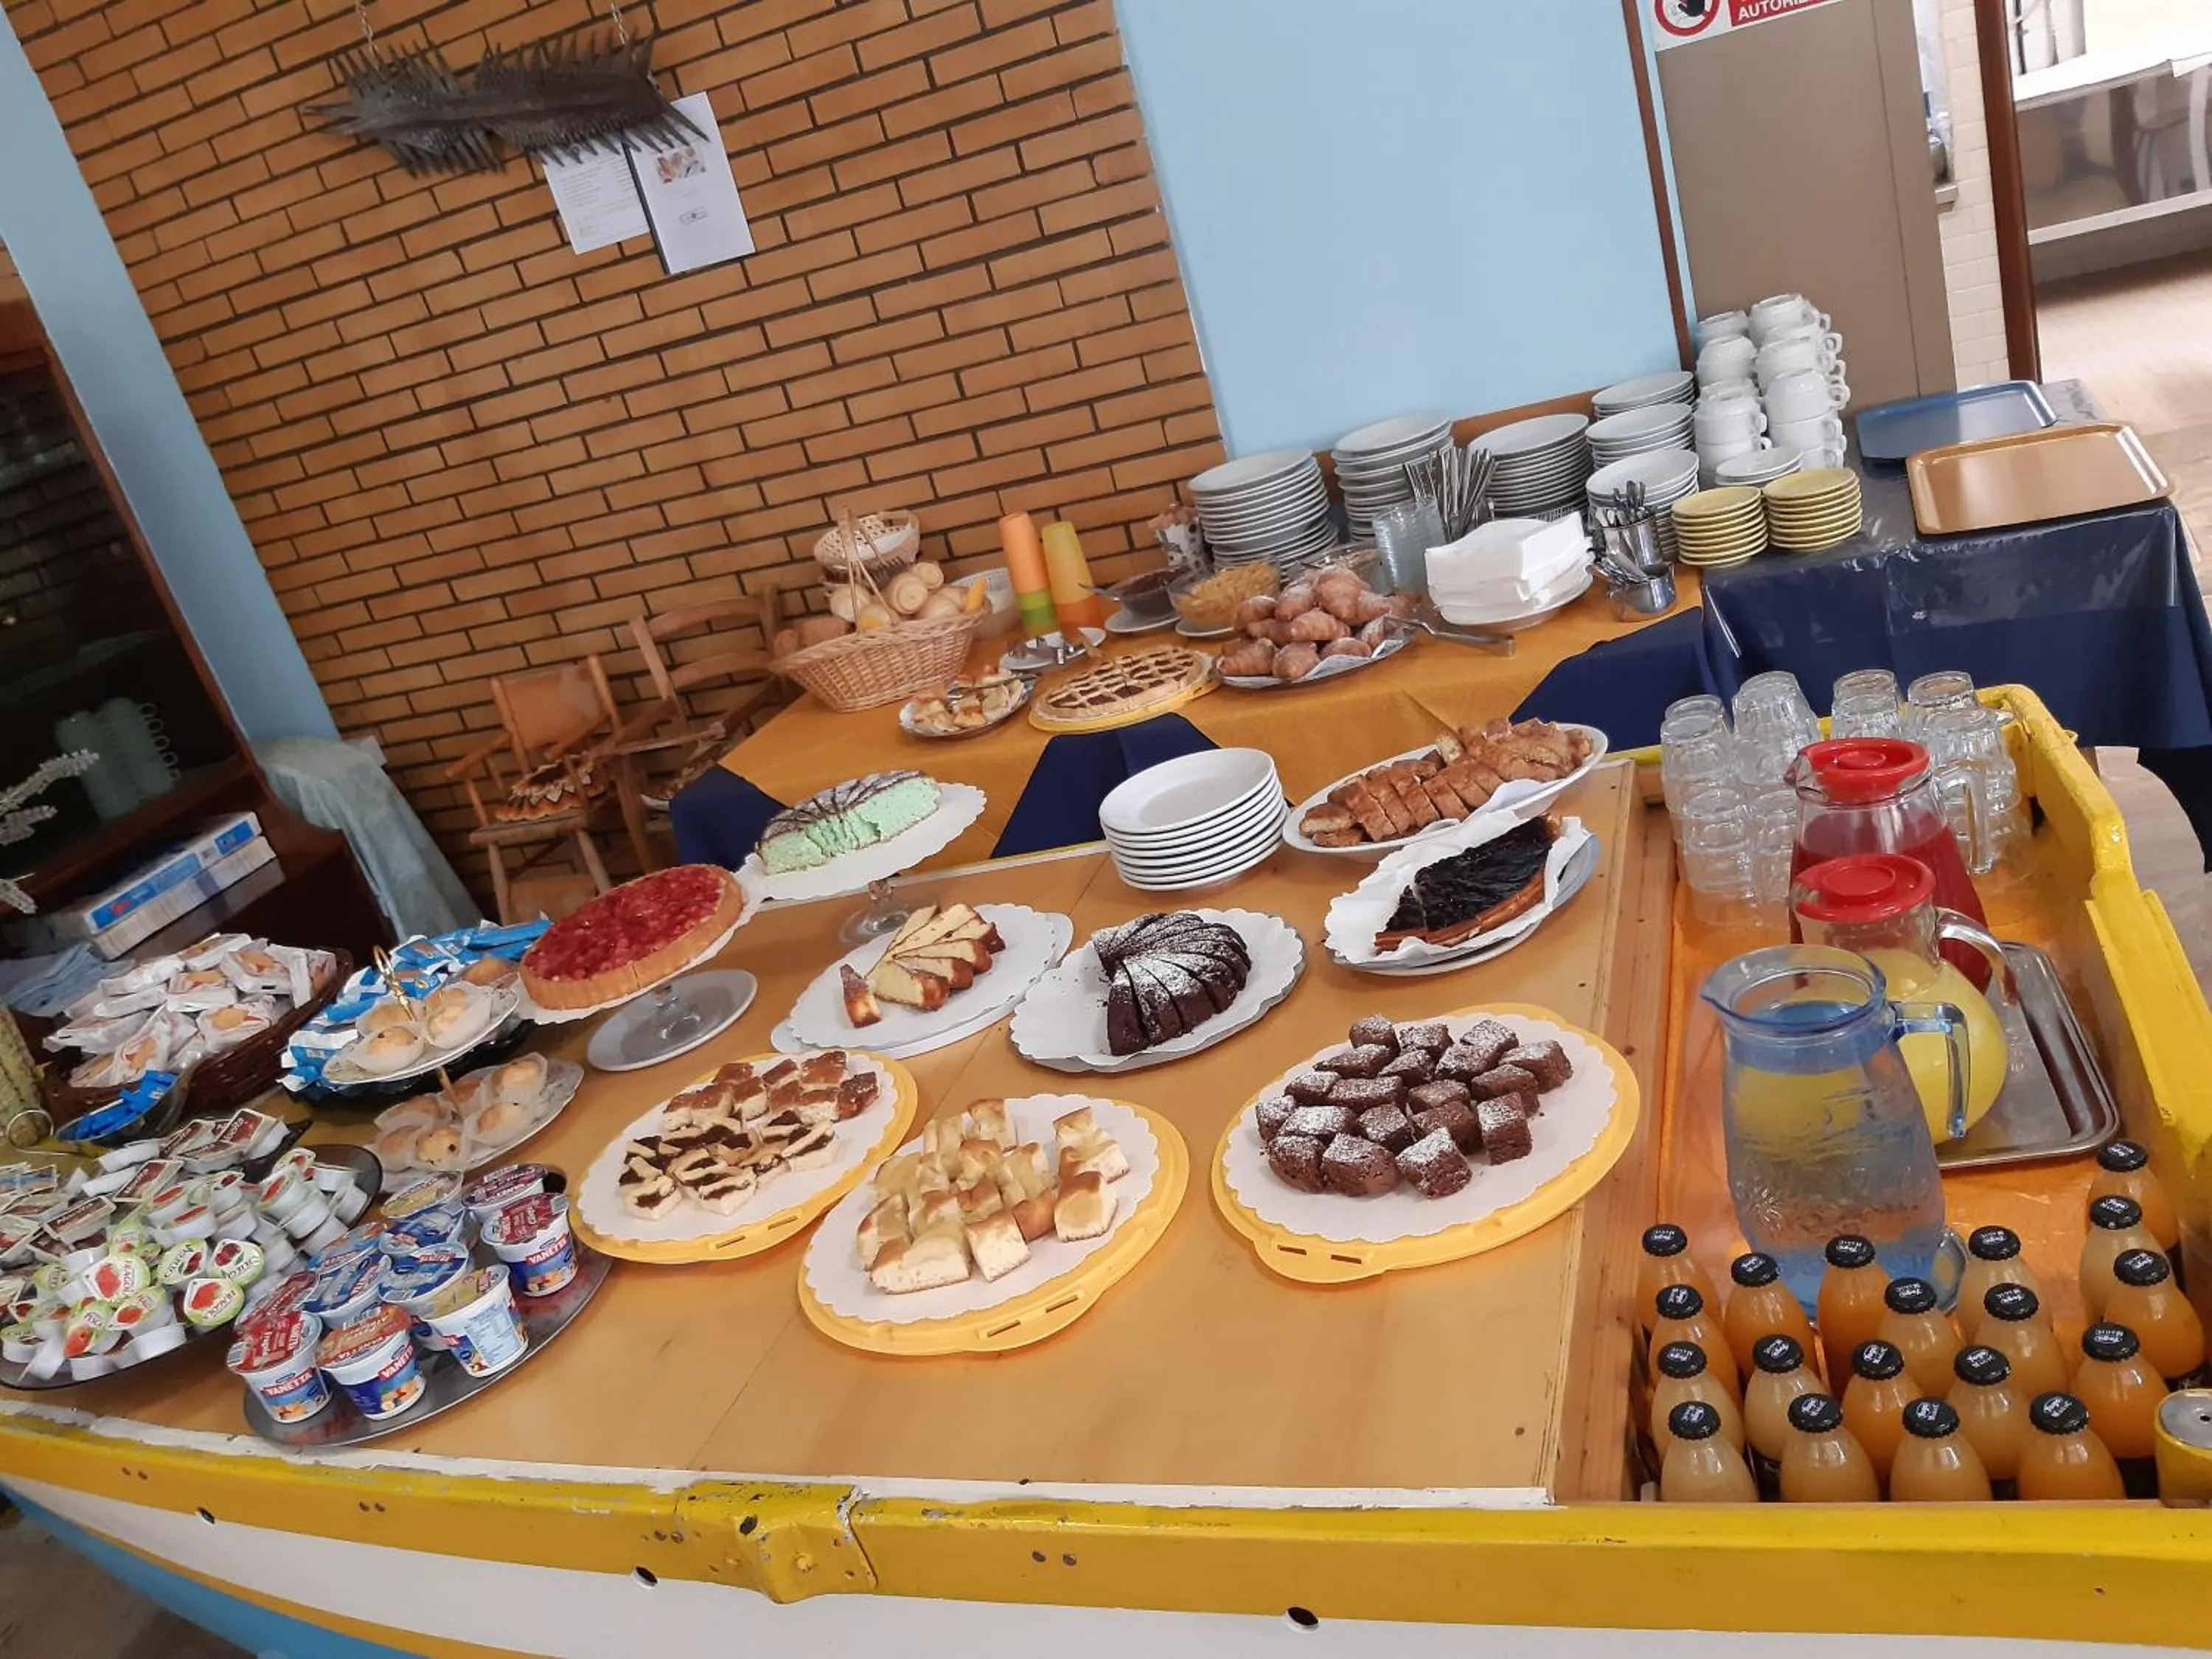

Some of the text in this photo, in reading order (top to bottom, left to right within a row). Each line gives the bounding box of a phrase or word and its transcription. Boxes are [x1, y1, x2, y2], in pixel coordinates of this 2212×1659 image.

[1738, 0, 1809, 21] AUTOR
[381, 1345, 414, 1379] VANETT
[266, 1371, 313, 1396] VANETTA
